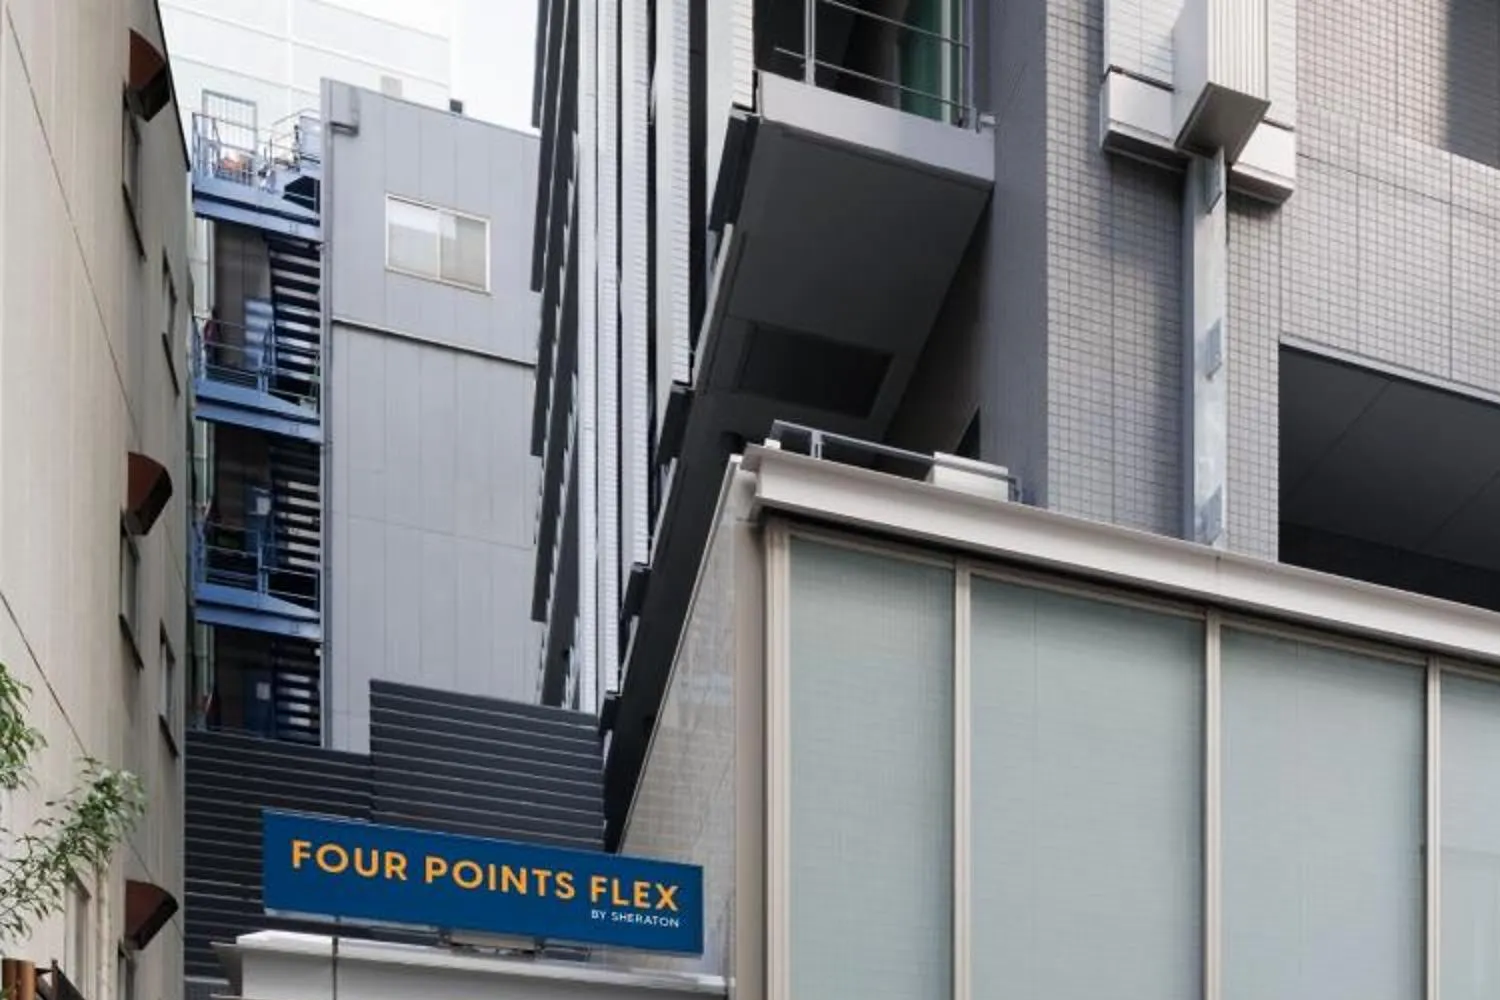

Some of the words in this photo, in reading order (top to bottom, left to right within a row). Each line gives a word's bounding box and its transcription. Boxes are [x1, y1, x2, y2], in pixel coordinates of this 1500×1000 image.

[291, 840, 407, 881] FOUR
[424, 855, 576, 900] POINTS
[590, 875, 679, 911] FLEX
[591, 908, 607, 920] BY
[611, 910, 680, 928] SHERATON
